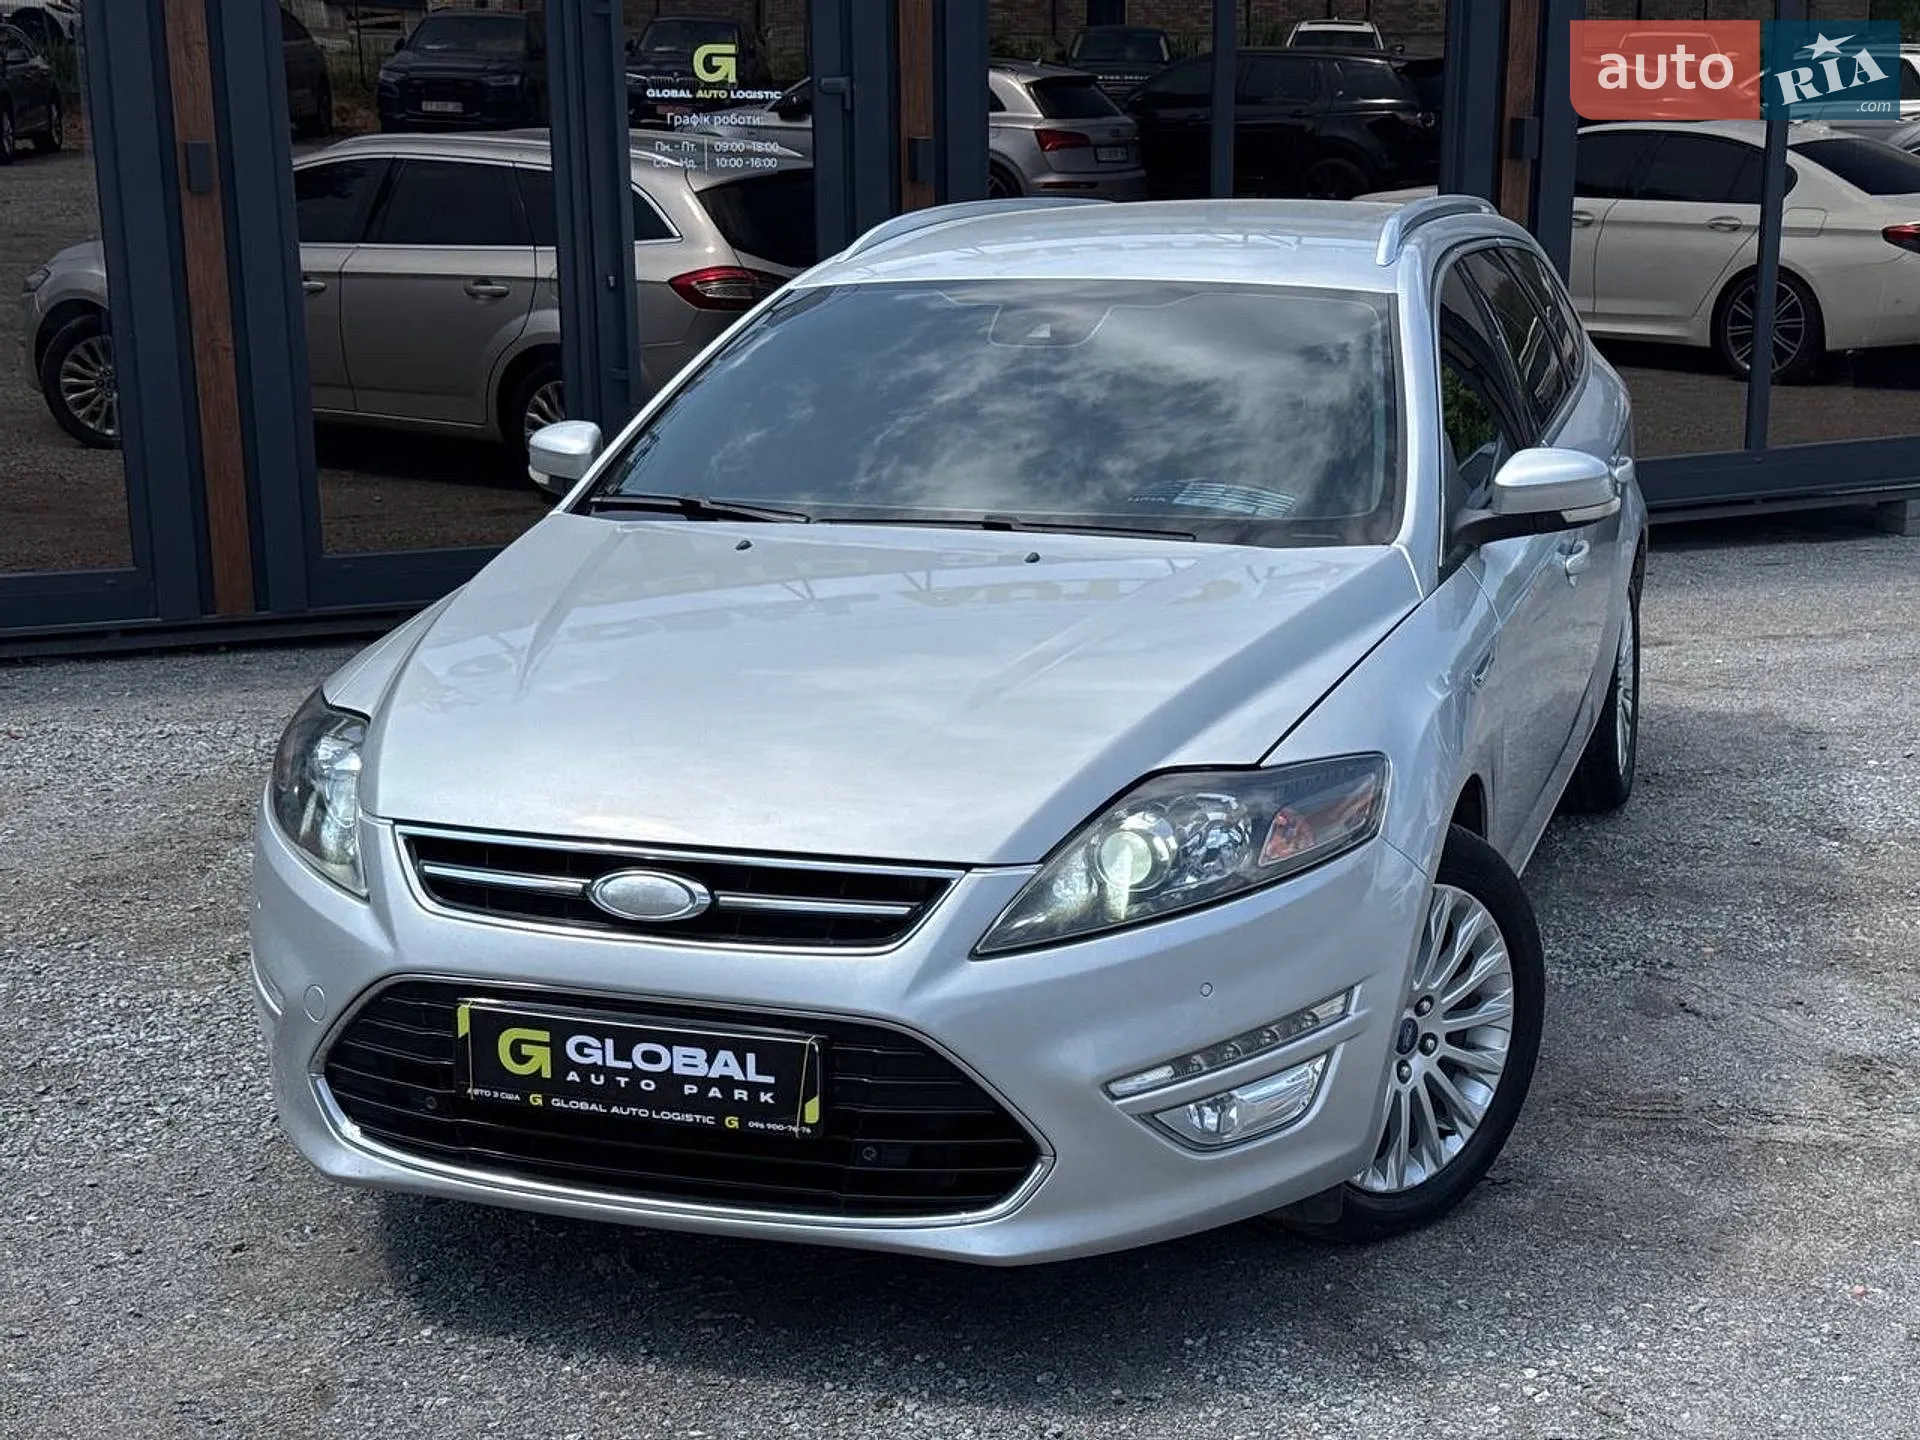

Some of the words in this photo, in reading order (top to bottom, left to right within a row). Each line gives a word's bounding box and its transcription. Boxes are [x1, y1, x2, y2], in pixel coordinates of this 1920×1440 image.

[646, 88, 693, 98] GLOBAL
[696, 89, 728, 99] AUTO
[730, 89, 782, 99] LOGISTIC
[667, 112, 712, 126] Графік
[715, 157, 744, 168] 10:00
[565, 1034, 776, 1084] GLOBAL
[566, 1070, 657, 1091] AUTO
[683, 1083, 776, 1104] PARK
[551, 1097, 608, 1113] GLOBAL
[610, 1105, 649, 1118] AUTO
[651, 1109, 715, 1124] LOGISTIC
